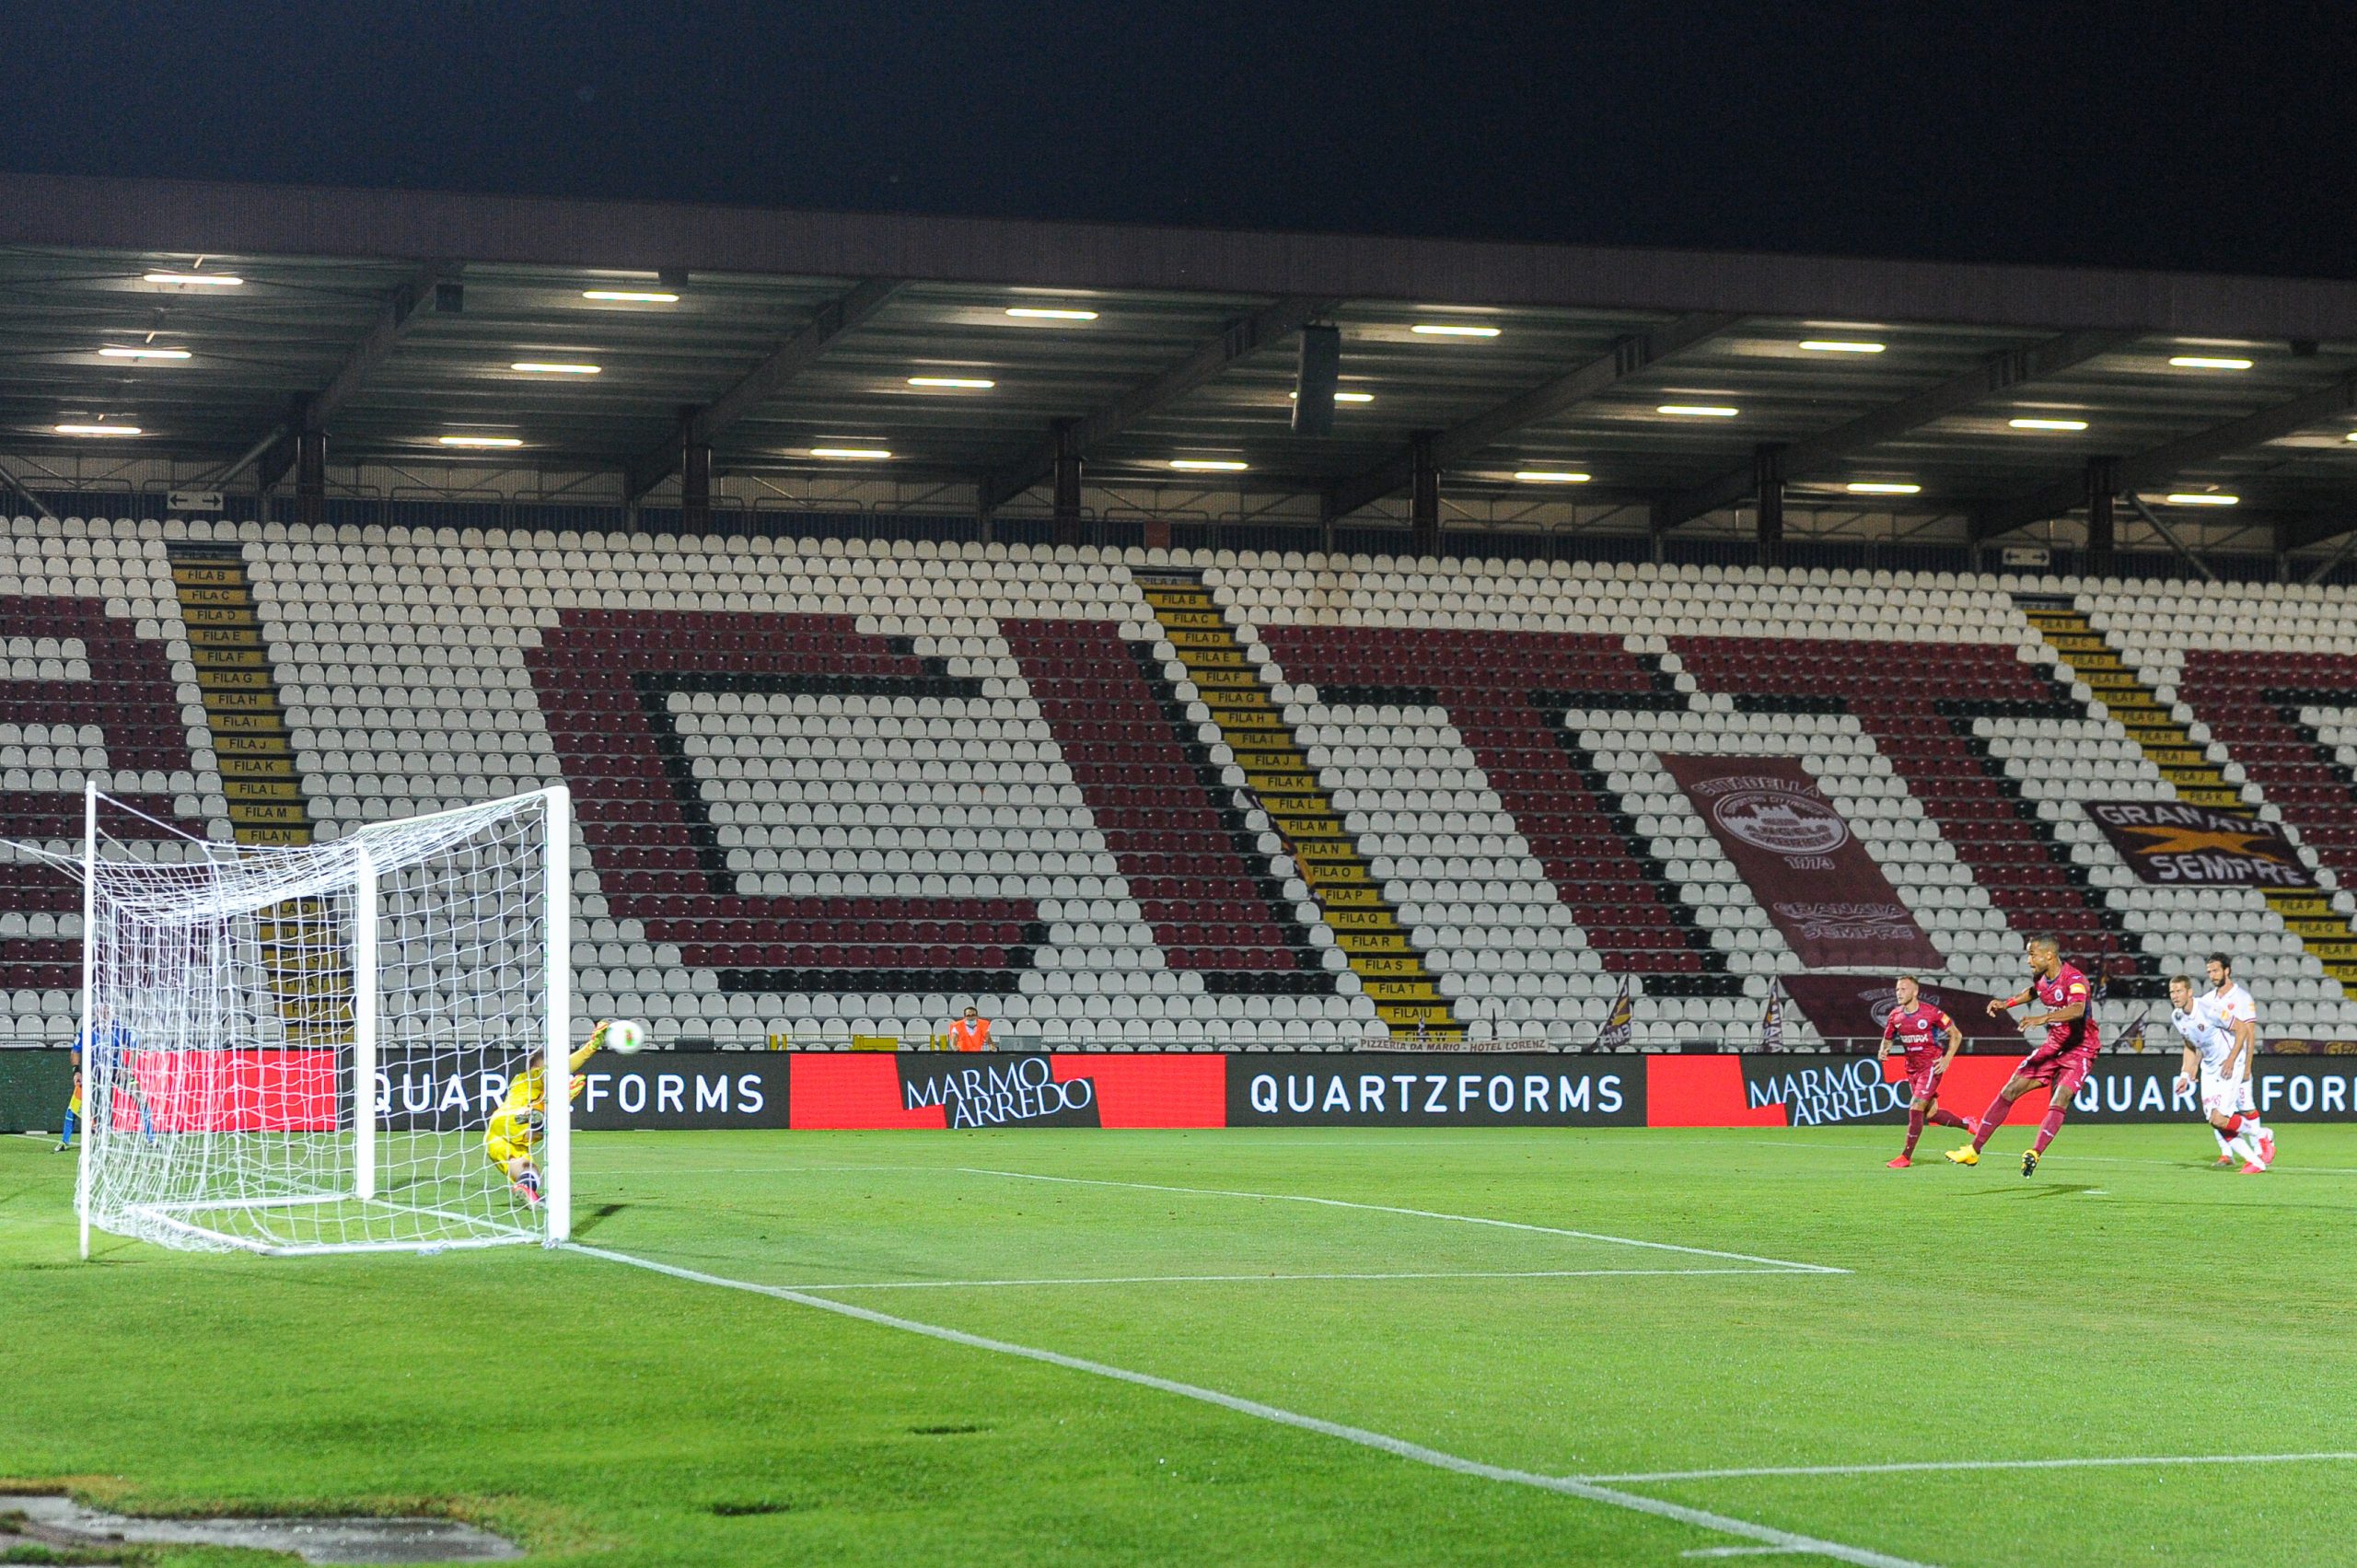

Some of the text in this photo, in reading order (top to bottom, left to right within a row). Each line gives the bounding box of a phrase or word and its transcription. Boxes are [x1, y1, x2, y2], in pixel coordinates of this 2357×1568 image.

[188, 570, 225, 580] FILA B
[192, 590, 229, 600] FILA C
[1162, 596, 1196, 604] FILA B
[197, 610, 235, 620] FILA D
[1174, 614, 1208, 624] FILA C
[203, 631, 240, 641] FILA E
[1185, 633, 1219, 642] FILA D
[208, 652, 245, 662] FILA F
[1196, 653, 1219, 662] FILA
[213, 673, 252, 683] FILA G
[219, 695, 257, 704] FILA H
[1219, 693, 1254, 702] FILA G
[223, 716, 257, 726] FILA I
[1229, 714, 1264, 722] FILA H
[230, 739, 266, 749] FILA J
[1243, 735, 1273, 743] FILA I
[234, 761, 274, 771] FILA K
[1255, 756, 1289, 766] FILA J
[1268, 777, 1304, 786] FILA K
[240, 784, 277, 795] FILA L
[1279, 800, 1314, 809] FILA L
[245, 807, 287, 817] FILA M
[1289, 821, 1327, 830] FILA M
[251, 830, 290, 841] FILA N
[1302, 845, 1339, 854] FILA N
[1313, 867, 1351, 877] FILA O
[2149, 854, 2307, 886] SEMPRE
[1326, 890, 1363, 900] FILA P
[1339, 913, 1377, 923] FILA Q
[1352, 937, 1390, 946] FILA R
[1365, 960, 1403, 970] FILA S
[1379, 984, 1415, 993] FILA T
[1393, 1008, 1432, 1018] FILA U
[1360, 1039, 1406, 1051] PIZZERIA
[1411, 1042, 1423, 1051] DA
[1427, 1042, 1460, 1051] MARIO
[1470, 1042, 1502, 1051] HOTEL
[907, 1057, 1049, 1110] MARMO
[1750, 1058, 1881, 1109] MARMO
[372, 1074, 764, 1113] QUARFORMS
[1250, 1074, 1623, 1113] QUARTZFORMS
[2073, 1075, 2357, 1113] QUARFOR
[954, 1078, 1092, 1129] ARREDO
